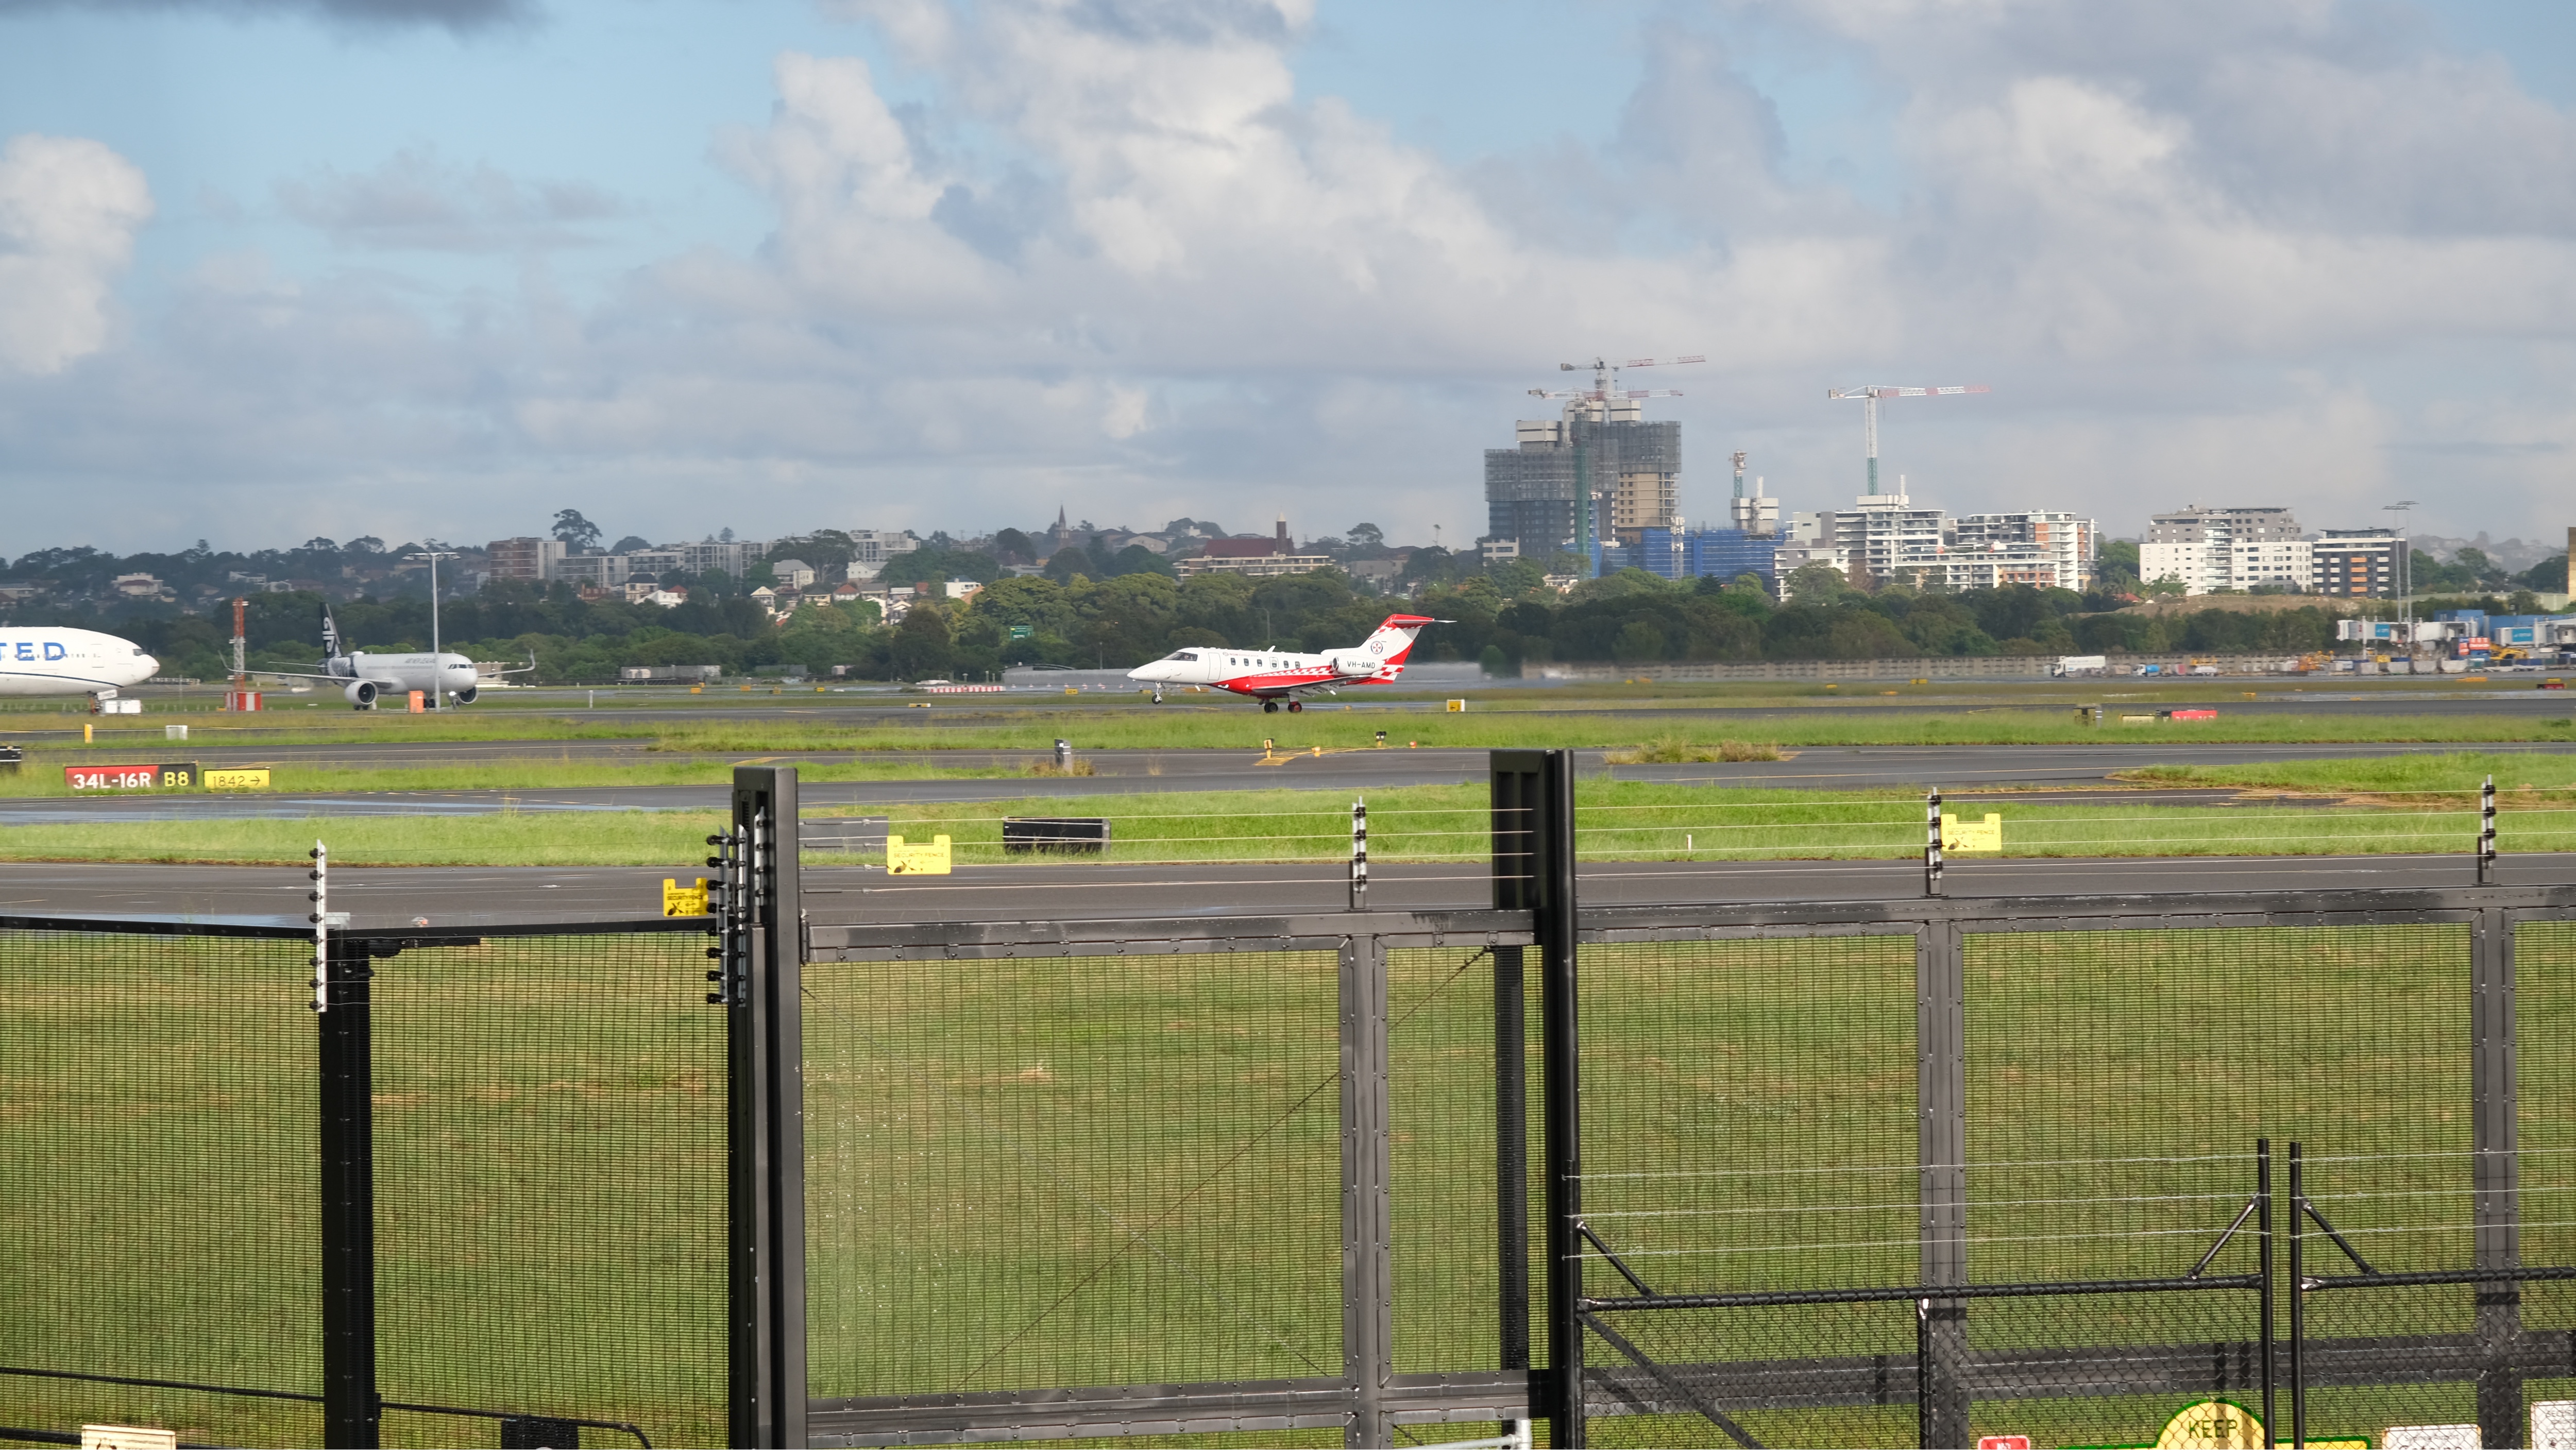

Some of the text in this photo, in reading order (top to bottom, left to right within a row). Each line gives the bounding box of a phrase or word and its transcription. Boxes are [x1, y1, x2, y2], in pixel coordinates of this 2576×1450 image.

[73, 772, 189, 789] 34L-16R B8
[213, 776, 245, 787] 1842
[2189, 1419, 2238, 1438] KEEP
